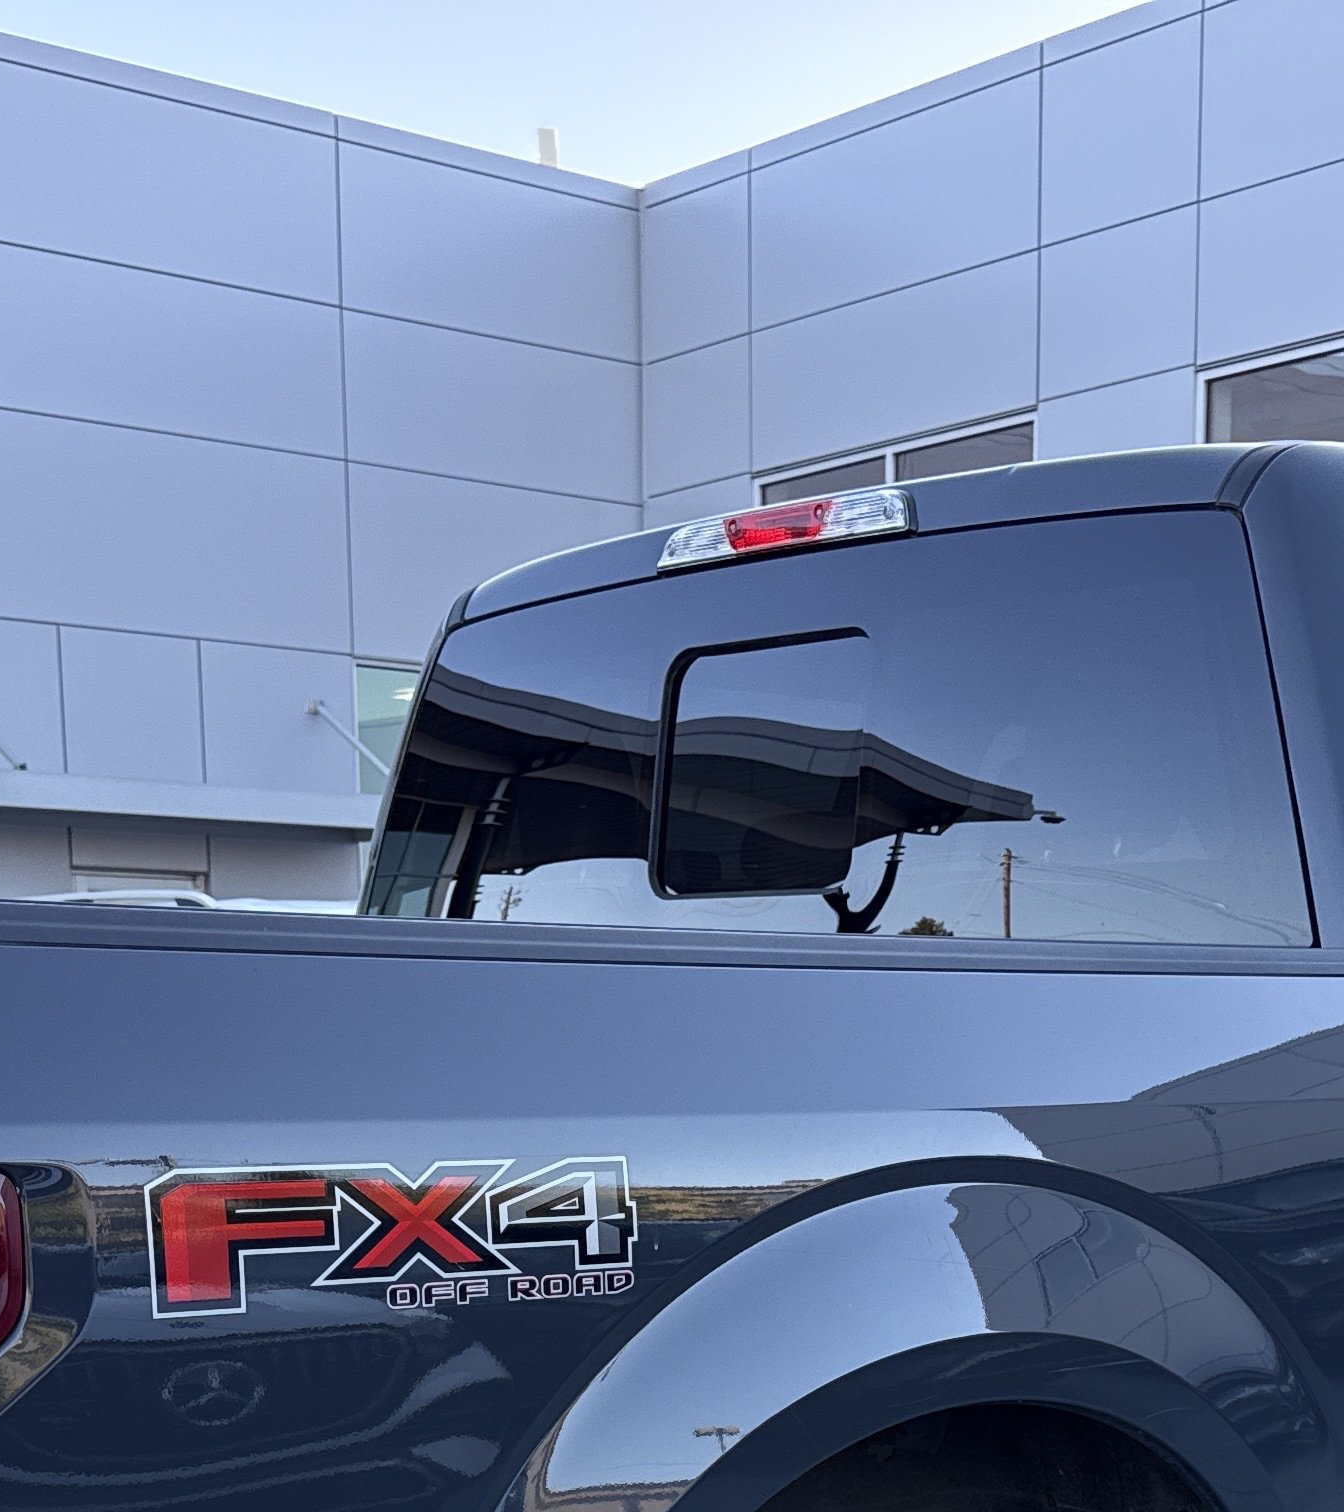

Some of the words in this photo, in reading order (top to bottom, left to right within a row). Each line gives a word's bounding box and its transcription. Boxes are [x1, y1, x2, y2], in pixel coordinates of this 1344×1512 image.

[144, 1156, 638, 1319] FX4
[387, 1278, 489, 1310] OFF
[508, 1269, 635, 1302] ROAD
